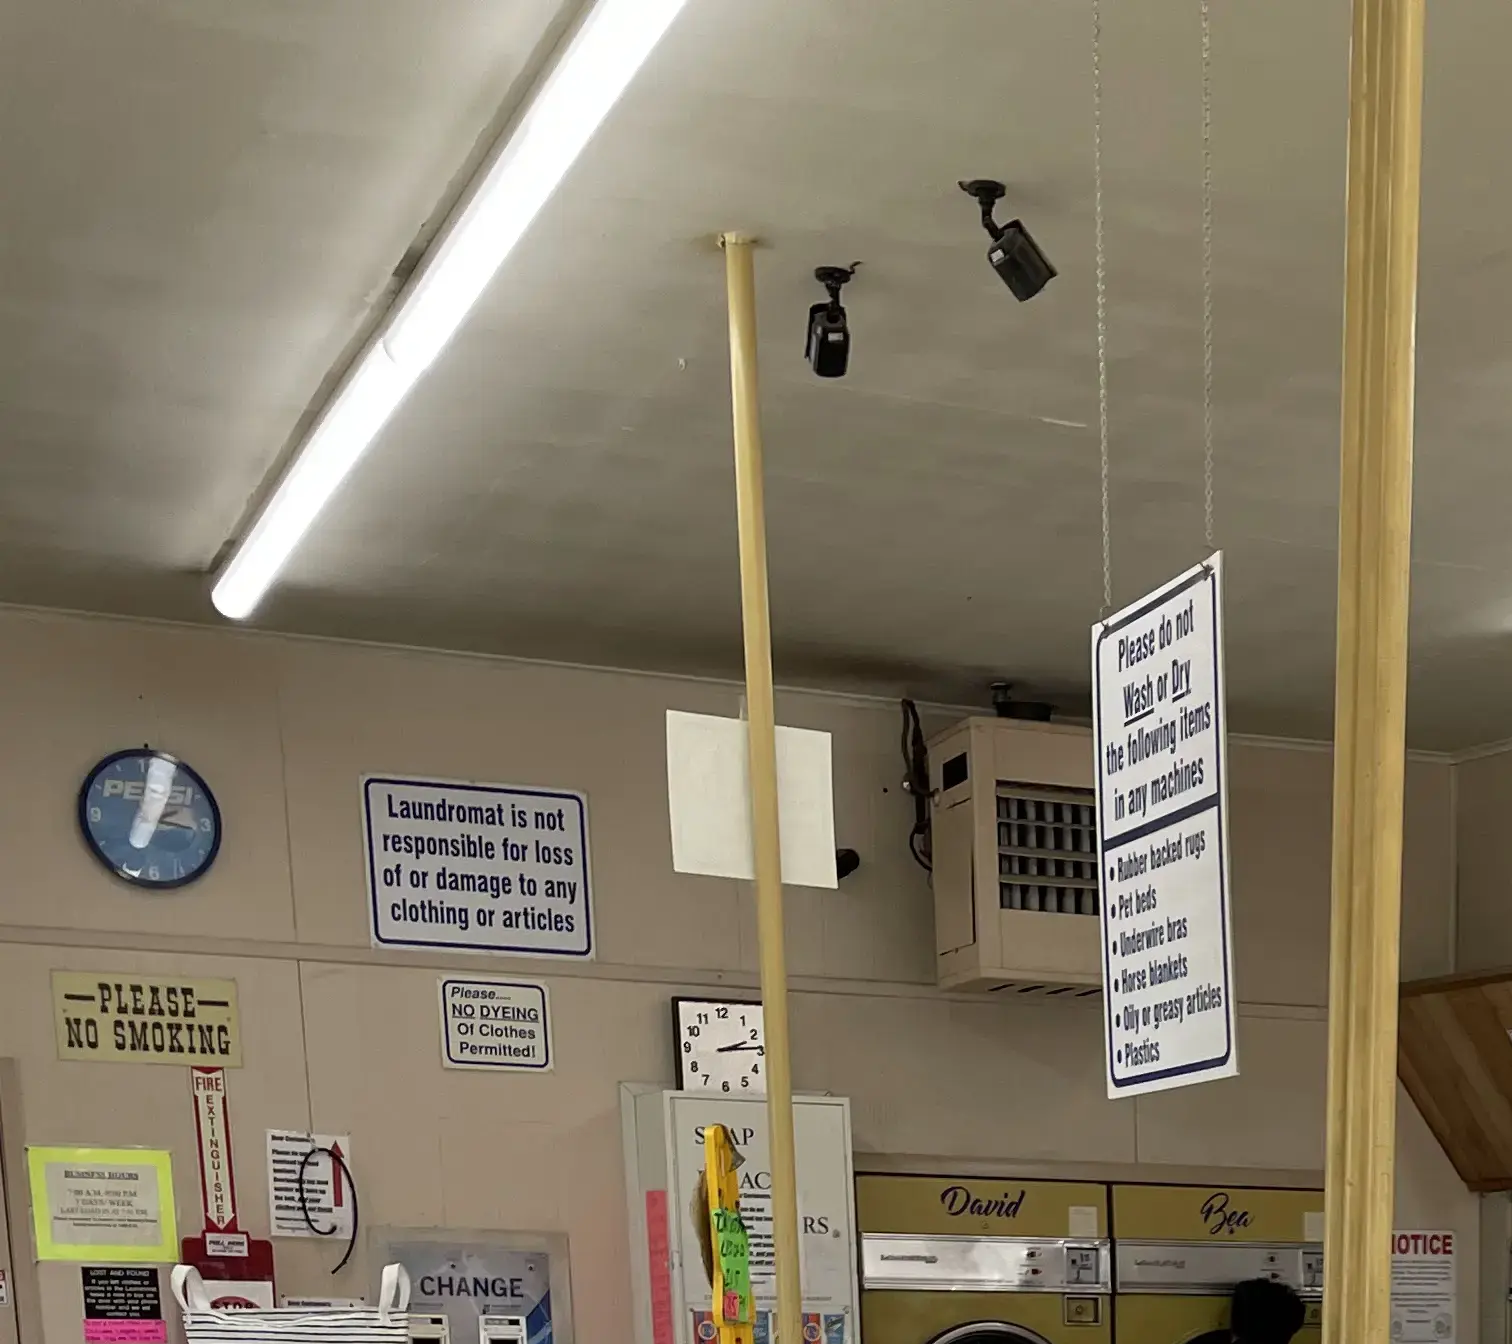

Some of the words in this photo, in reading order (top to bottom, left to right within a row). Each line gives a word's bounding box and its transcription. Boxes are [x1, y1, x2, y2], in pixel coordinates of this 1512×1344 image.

[1118, 627, 1156, 673] Please
[1158, 613, 1173, 651] do
[1175, 599, 1194, 642] not
[1123, 674, 1155, 721] Wash
[1156, 671, 1168, 703] or
[1171, 658, 1192, 697] Dry
[1106, 741, 1125, 777] the
[1127, 717, 1177, 768] following
[1179, 700, 1212, 742] items
[102, 779, 194, 806] PESI
[1114, 787, 1126, 822] in
[1128, 783, 1148, 818] any
[1150, 756, 1205, 807] machines
[387, 793, 505, 828] Laundromat
[511, 803, 528, 829] is
[534, 808, 565, 832] not
[382, 832, 496, 861] responsible
[502, 837, 529, 863] for
[535, 840, 574, 866] loss
[1117, 850, 1149, 883] Rubber
[1150, 831, 1184, 871] backed
[1185, 829, 1206, 861] rugs
[383, 863, 402, 888] of
[409, 867, 429, 889] or
[436, 866, 512, 899] damage
[519, 872, 538, 897] to
[544, 878, 578, 905] any
[391, 898, 470, 931] clothing
[476, 907, 496, 927] or
[502, 906, 575, 932] articles
[1118, 891, 1134, 921] Pet
[1135, 883, 1157, 915] beds
[1119, 920, 1165, 958] Underwire
[1166, 915, 1188, 943] bras
[1121, 963, 1147, 995] Horse
[1148, 952, 1189, 987] blankets
[97, 982, 197, 1018] PLEASE
[451, 1003, 475, 1019] NO
[480, 1004, 540, 1022] DYEING
[715, 1007, 729, 1019] 12
[1141, 1005, 1151, 1027] or
[1153, 995, 1184, 1031] greasy
[1186, 982, 1223, 1016] articles
[457, 1022, 475, 1036] Of
[479, 1023, 537, 1040] Clothes
[687, 1025, 700, 1037] 10
[697, 1013, 709, 1024] 11
[740, 1015, 746, 1026] 1
[65, 1016, 99, 1050] NO
[113, 1019, 231, 1056] SMOKING
[683, 1041, 691, 1053] 9
[749, 1028, 758, 1040] 2
[459, 1041, 536, 1059] Permitted!
[1124, 1037, 1161, 1069] Plastics
[690, 1060, 699, 1073] 8
[701, 1074, 710, 1086] 7
[751, 1063, 759, 1075] 4
[195, 1076, 223, 1091] FIRE
[721, 1081, 730, 1093] 6
[740, 1076, 749, 1088] 5
[694, 1126, 754, 1146] SAP
[205, 1093, 226, 1225] EXTINGUISHER
[940, 1186, 1026, 1218] David
[1200, 1192, 1255, 1234] Bea
[1391, 1234, 1453, 1255] OTICE
[420, 1276, 524, 1298] CHANGE
